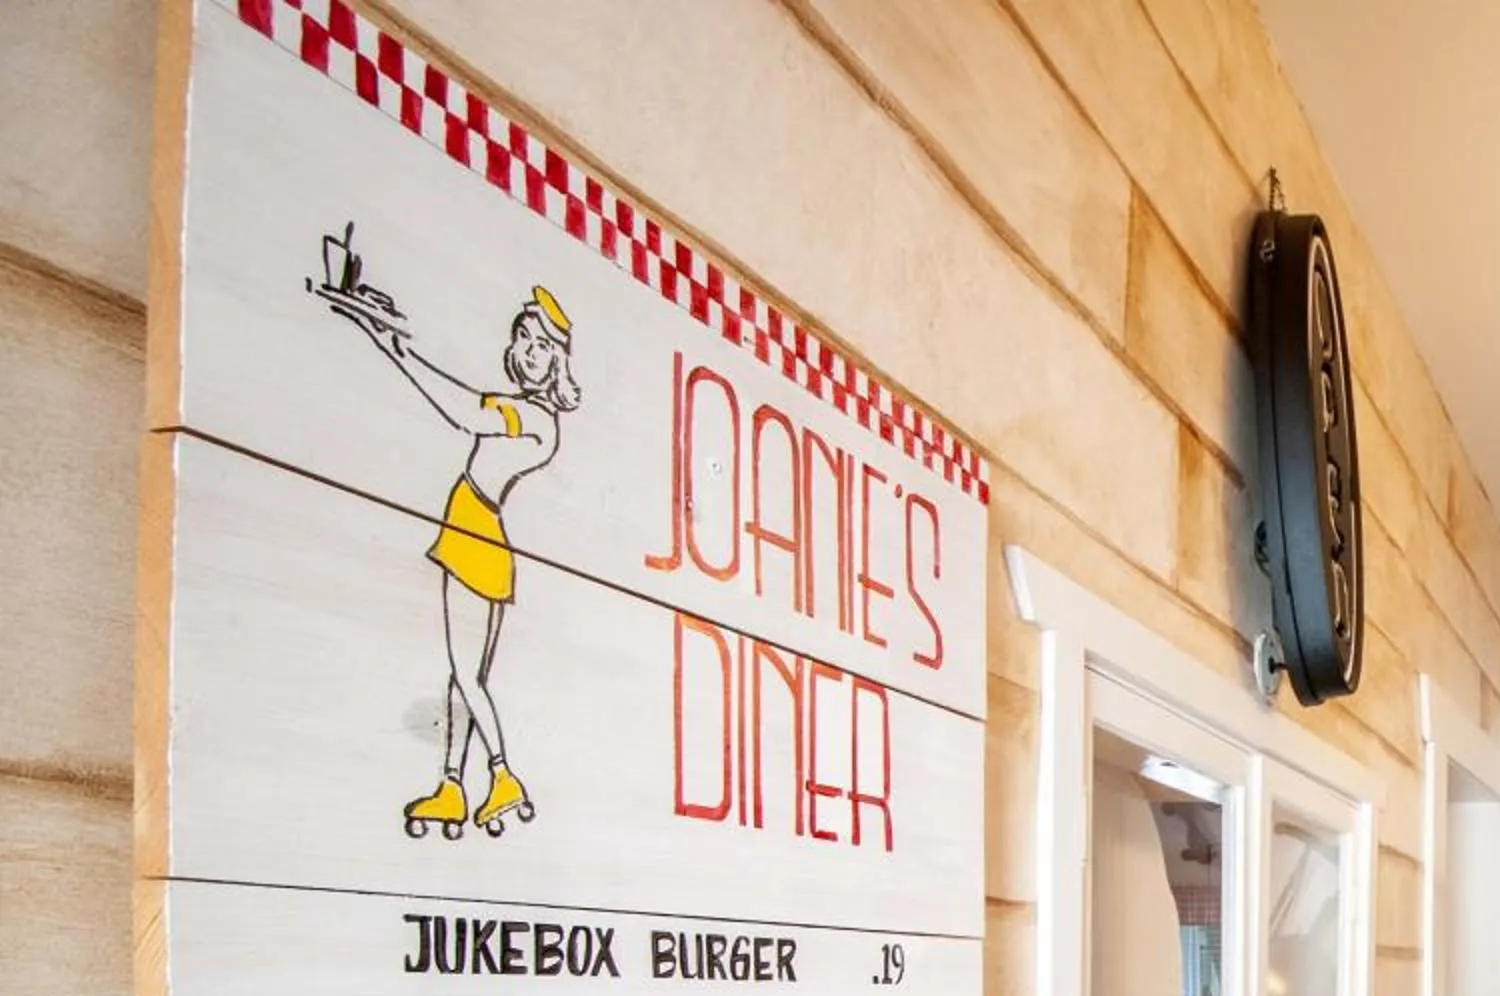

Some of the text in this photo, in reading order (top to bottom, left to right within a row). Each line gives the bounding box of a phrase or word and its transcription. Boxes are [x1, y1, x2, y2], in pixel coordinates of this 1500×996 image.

[645, 351, 944, 670] JOANIE'S
[674, 611, 895, 852] DINER
[403, 913, 797, 982] JUKEBOX BURGER
[872, 943, 906, 986] .19
